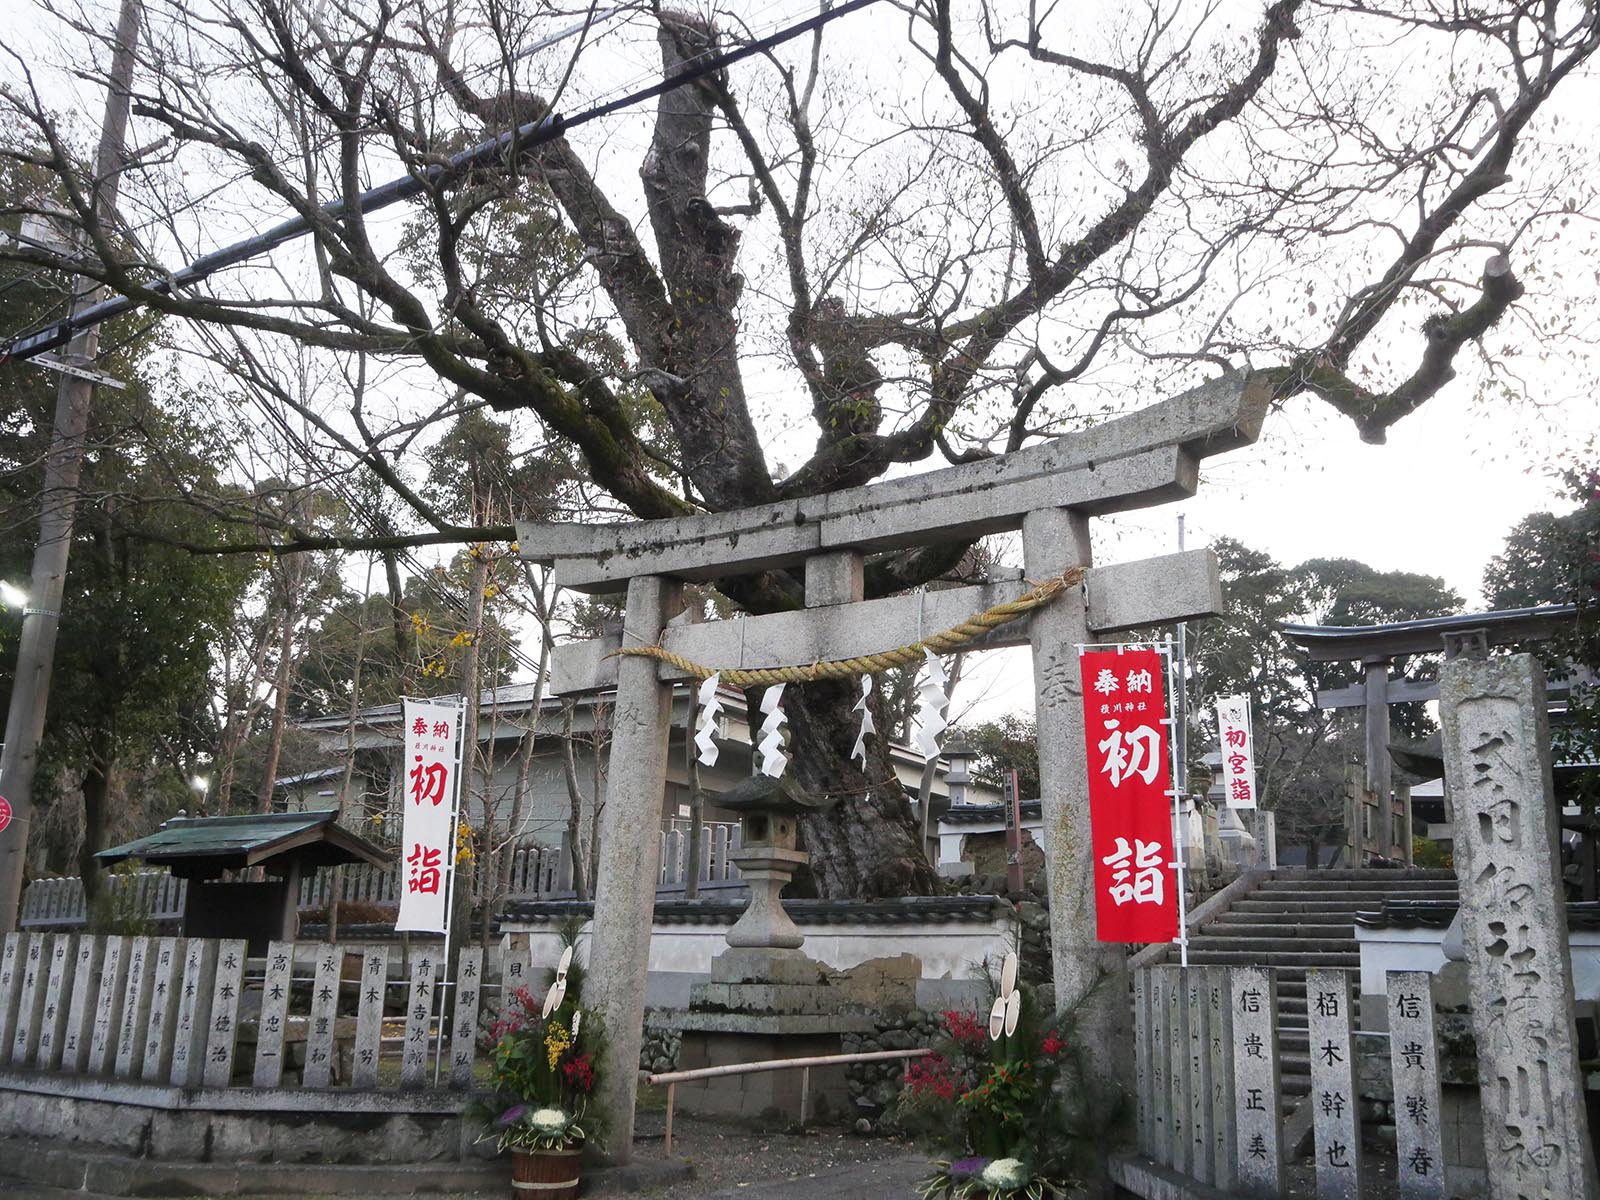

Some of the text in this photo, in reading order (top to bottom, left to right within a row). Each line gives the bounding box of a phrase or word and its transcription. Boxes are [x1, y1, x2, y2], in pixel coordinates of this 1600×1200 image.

[412, 717, 449, 740] 奉納
[1093, 668, 1152, 697] 奉納
[1100, 701, 1147, 715] 積川神社
[1098, 719, 1165, 907] 初詣
[1225, 726, 1252, 801] 初宮詣
[407, 755, 449, 896] 初詣
[262, 953, 288, 1058] 高木忠一
[311, 955, 336, 1065] 永本豊和
[359, 956, 383, 1065] 青木努
[407, 958, 432, 1067] 青木吉次郎
[455, 960, 477, 1067] 永野善弘
[1240, 988, 1267, 1161] 信貴正美
[1316, 991, 1350, 1168] 栢木幹也
[1396, 993, 1434, 1177] 信貴繁春
